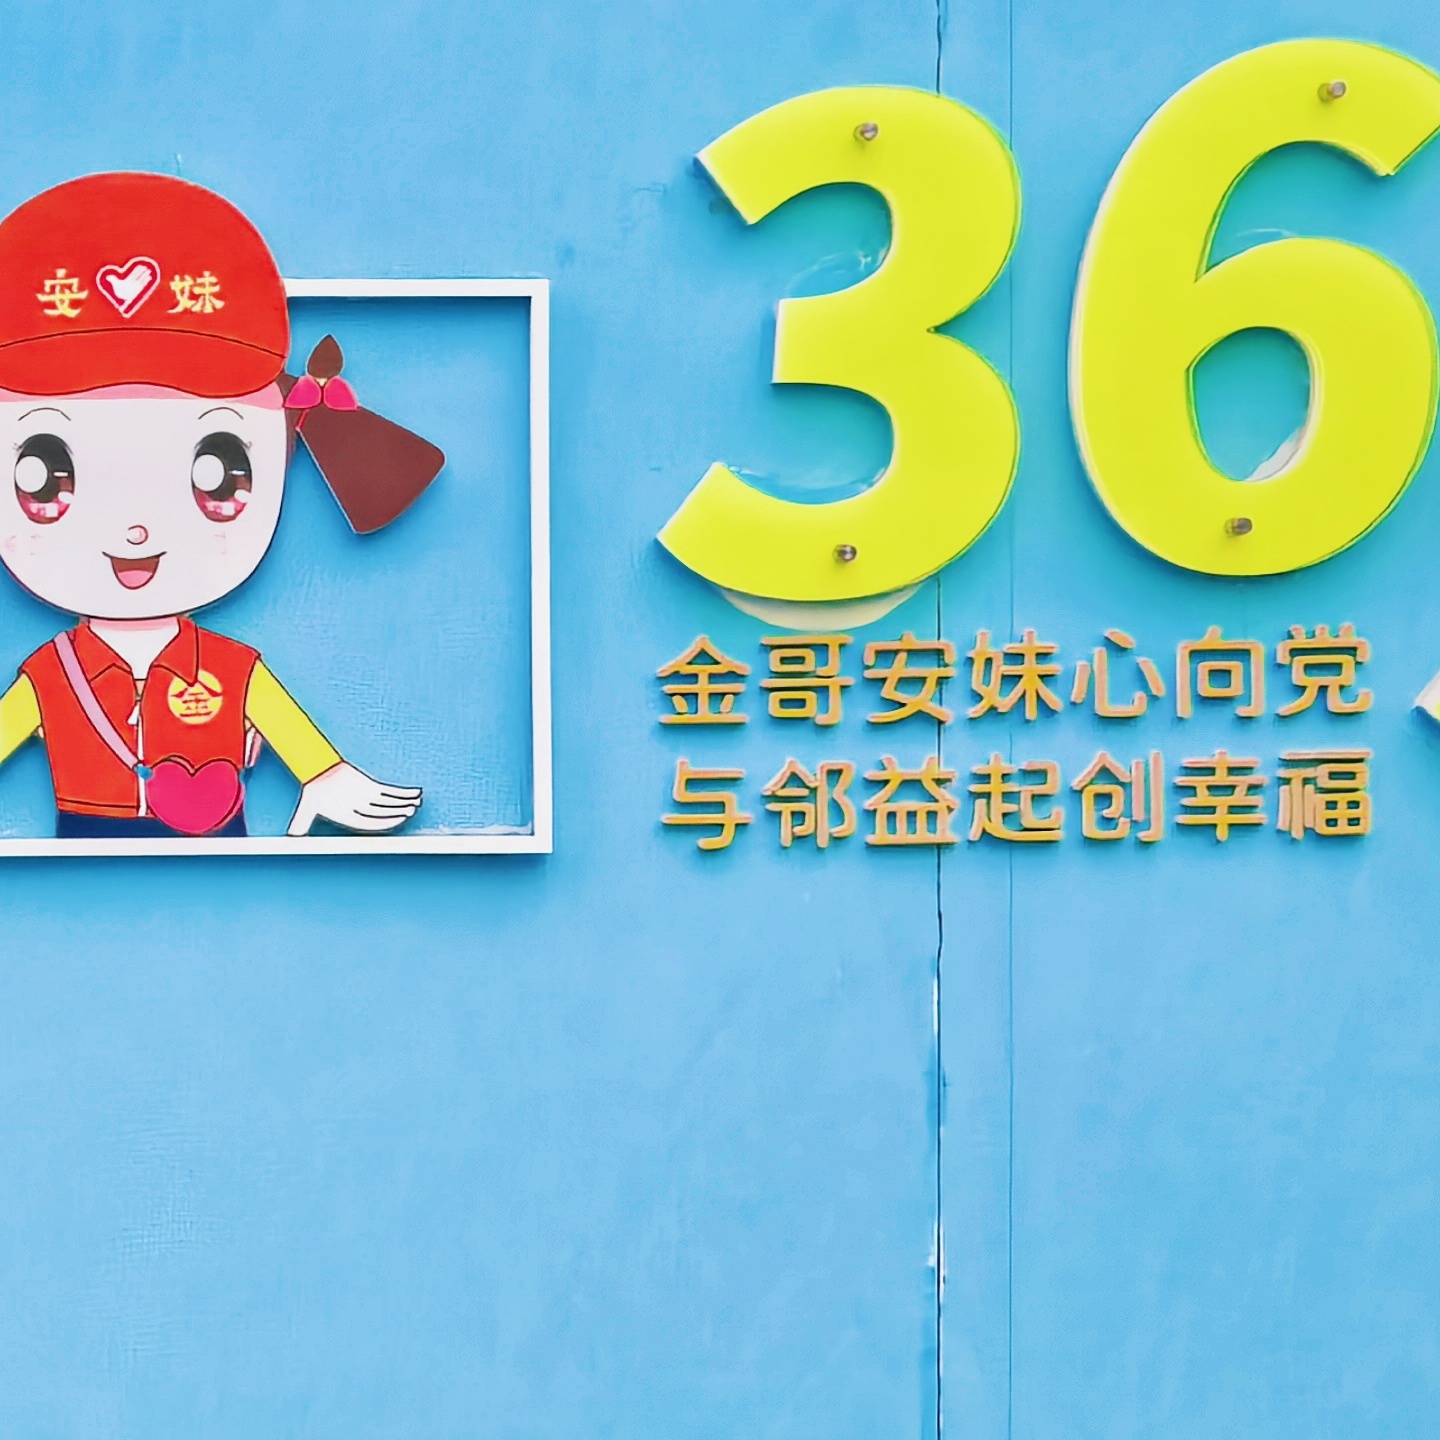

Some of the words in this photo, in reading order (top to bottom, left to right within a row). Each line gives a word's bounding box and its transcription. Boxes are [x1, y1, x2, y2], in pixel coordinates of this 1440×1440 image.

[655, 622, 1375, 728] 金哥安妹心向党
[661, 749, 1374, 853] 与邻益起创幸福
